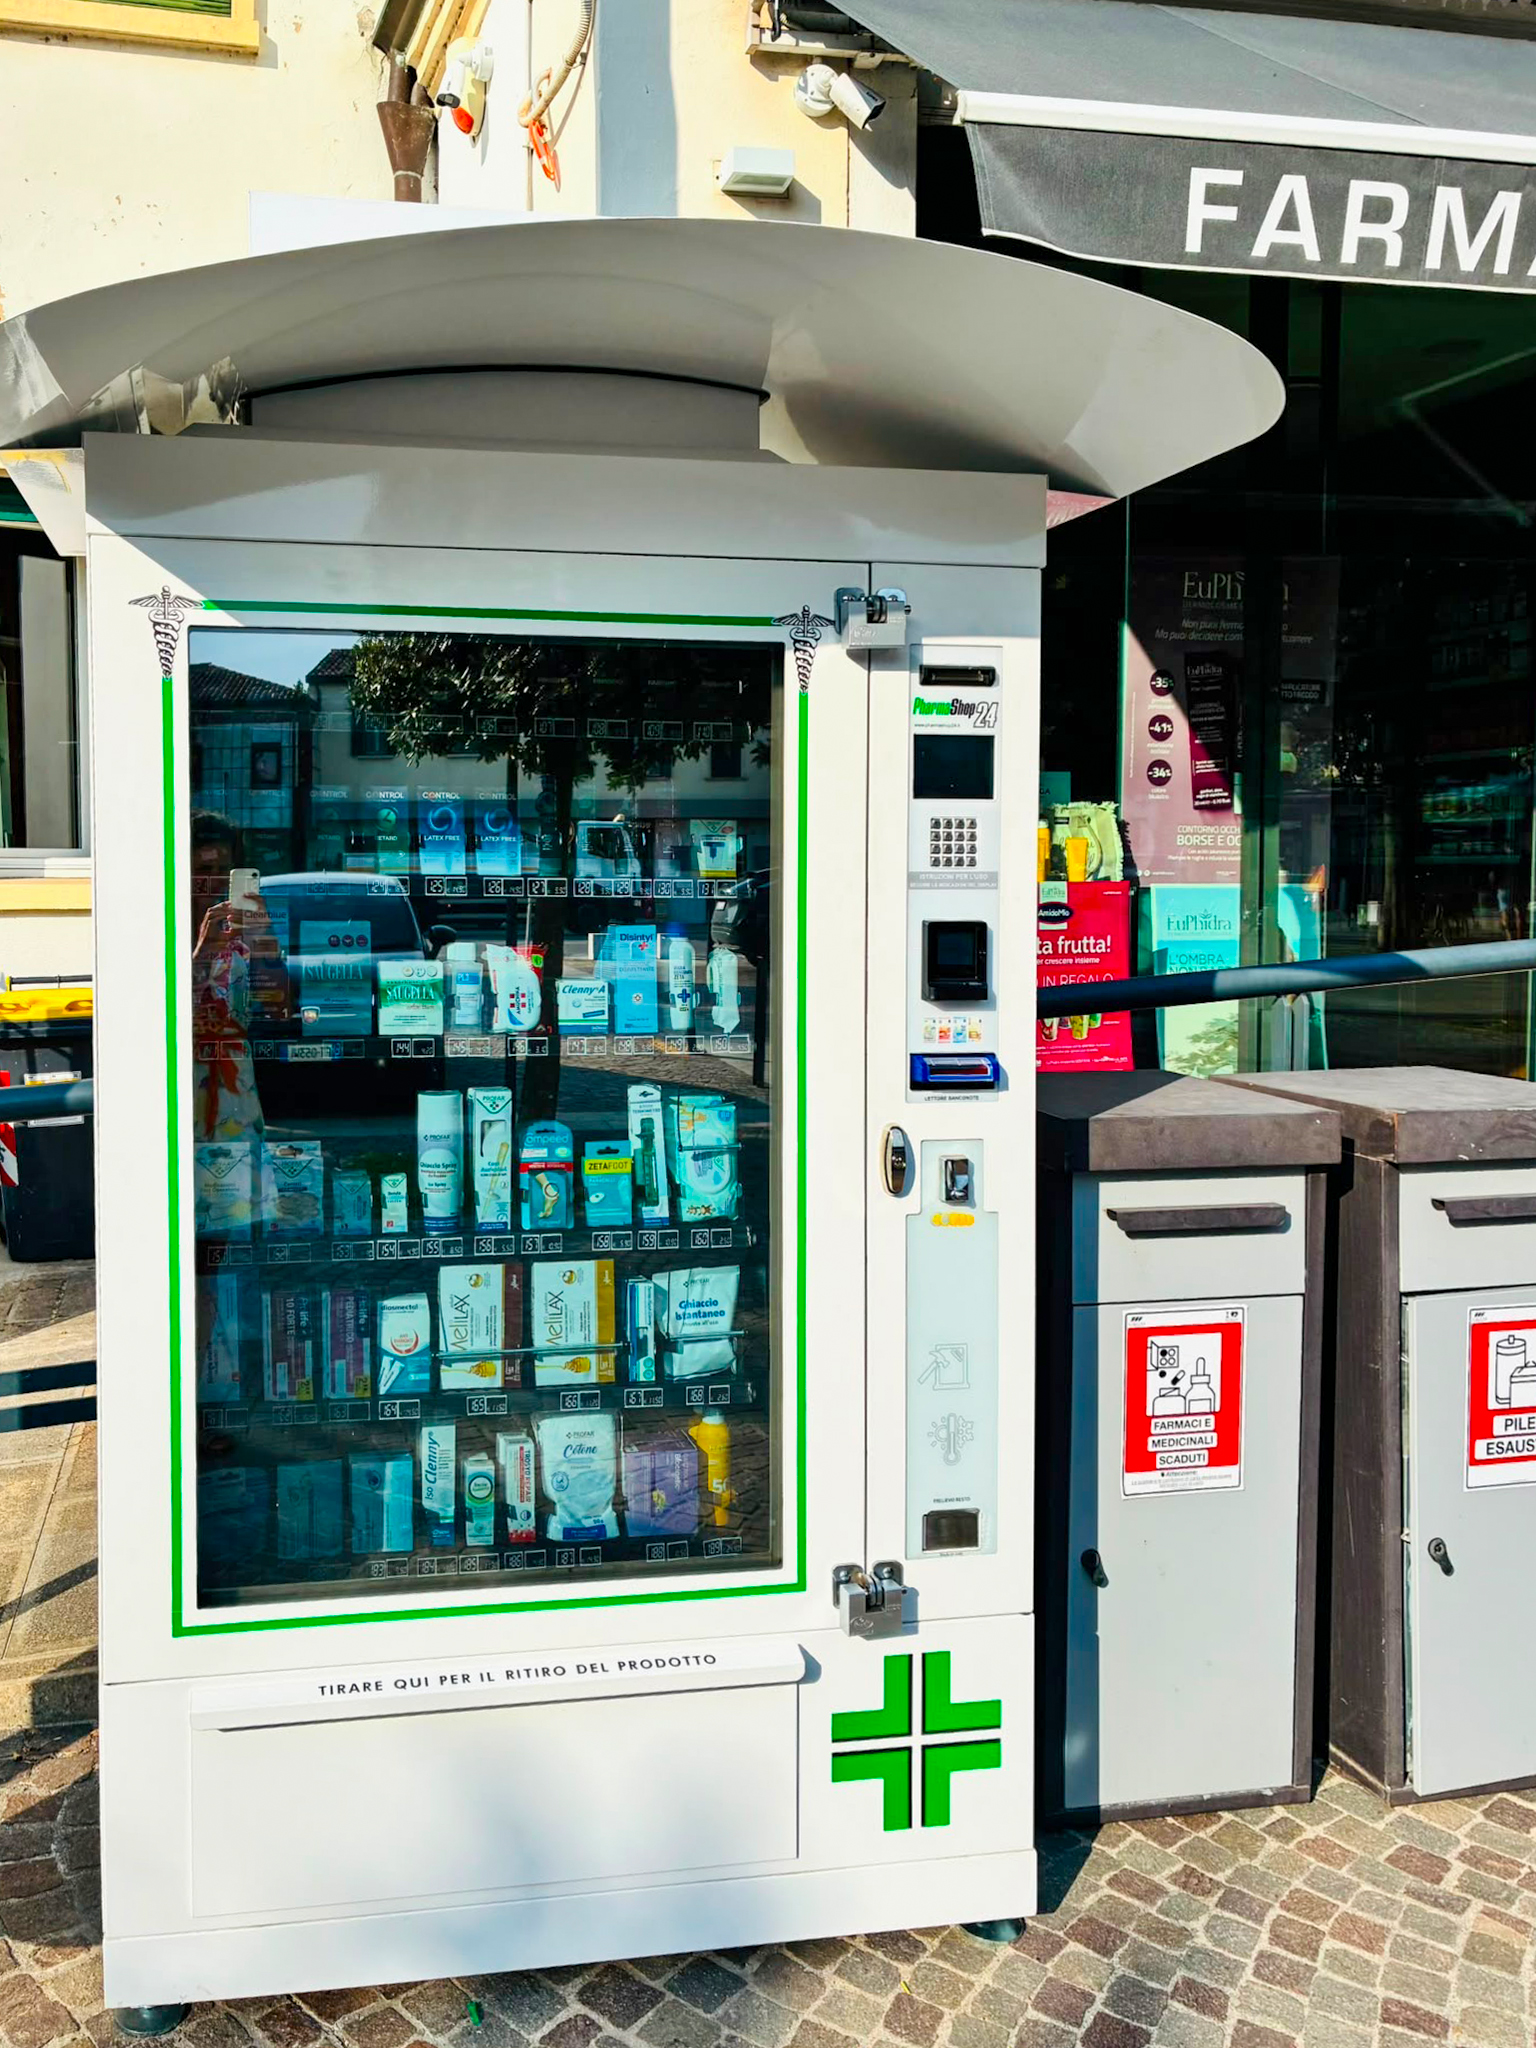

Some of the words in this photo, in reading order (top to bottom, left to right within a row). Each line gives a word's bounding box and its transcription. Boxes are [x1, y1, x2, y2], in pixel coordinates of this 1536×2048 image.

[1185, 167, 1536, 276] FARM
[1148, 767, 1172, 778] -34%
[422, 791, 460, 799] CONTROL
[1178, 825, 1219, 834] CONTORNO
[1220, 825, 1241, 833] OCCH
[1177, 835, 1214, 846] BORSE
[1218, 835, 1224, 846] E
[1226, 835, 1242, 846] OC
[430, 879, 443, 893] 125
[489, 880, 501, 893] 126
[532, 881, 544, 894] 127
[578, 881, 591, 894] 128
[616, 881, 629, 894] 129
[658, 882, 671, 895] 130
[702, 883, 715, 896] 131
[244, 911, 287, 919] Clearblue
[1167, 914, 1231, 931] EuPhidra
[620, 933, 653, 942] Disintyl
[1057, 934, 1111, 954] frutta!
[1169, 953, 1225, 965] L'OMBRA
[1042, 974, 1056, 987] IN
[386, 985, 434, 1000] SAUGELLA
[562, 985, 595, 995] Clenny
[598, 985, 605, 993] A
[524, 1133, 569, 1147] Compeed
[588, 1161, 628, 1170] ZETAFOOT
[525, 1238, 538, 1251] 157
[597, 1235, 609, 1248] 158
[642, 1233, 655, 1246] 159
[695, 1232, 708, 1245] 160
[381, 1243, 395, 1256] 154
[426, 1241, 439, 1255] 155
[479, 1239, 491, 1252] 156
[381, 1303, 418, 1311] diosmectal
[679, 1298, 719, 1309] Ghiaccio
[565, 1395, 577, 1408] 166
[629, 1392, 642, 1405] 167
[691, 1389, 703, 1402] 168
[384, 1404, 397, 1417] 164
[472, 1399, 484, 1412] 165
[1154, 1419, 1201, 1431] FARMACI
[1205, 1418, 1211, 1427] E
[1504, 1416, 1536, 1431] PILE
[1151, 1435, 1214, 1448] MEDICINALI
[1486, 1439, 1536, 1455] ESAUS
[563, 1444, 597, 1459] Cotone
[1159, 1453, 1205, 1465] SCADUTI
[425, 1487, 434, 1500] Iso
[708, 1541, 720, 1553] 189
[562, 1552, 573, 1565] 187
[319, 1680, 384, 1696] TIRARE
[394, 1676, 429, 1691] QUI
[439, 1671, 471, 1685] PER
[480, 1670, 495, 1683] IL
[505, 1665, 567, 1681] RITIRO
[576, 1661, 609, 1675] DEL
[618, 1654, 718, 1672] PRODOTTO
